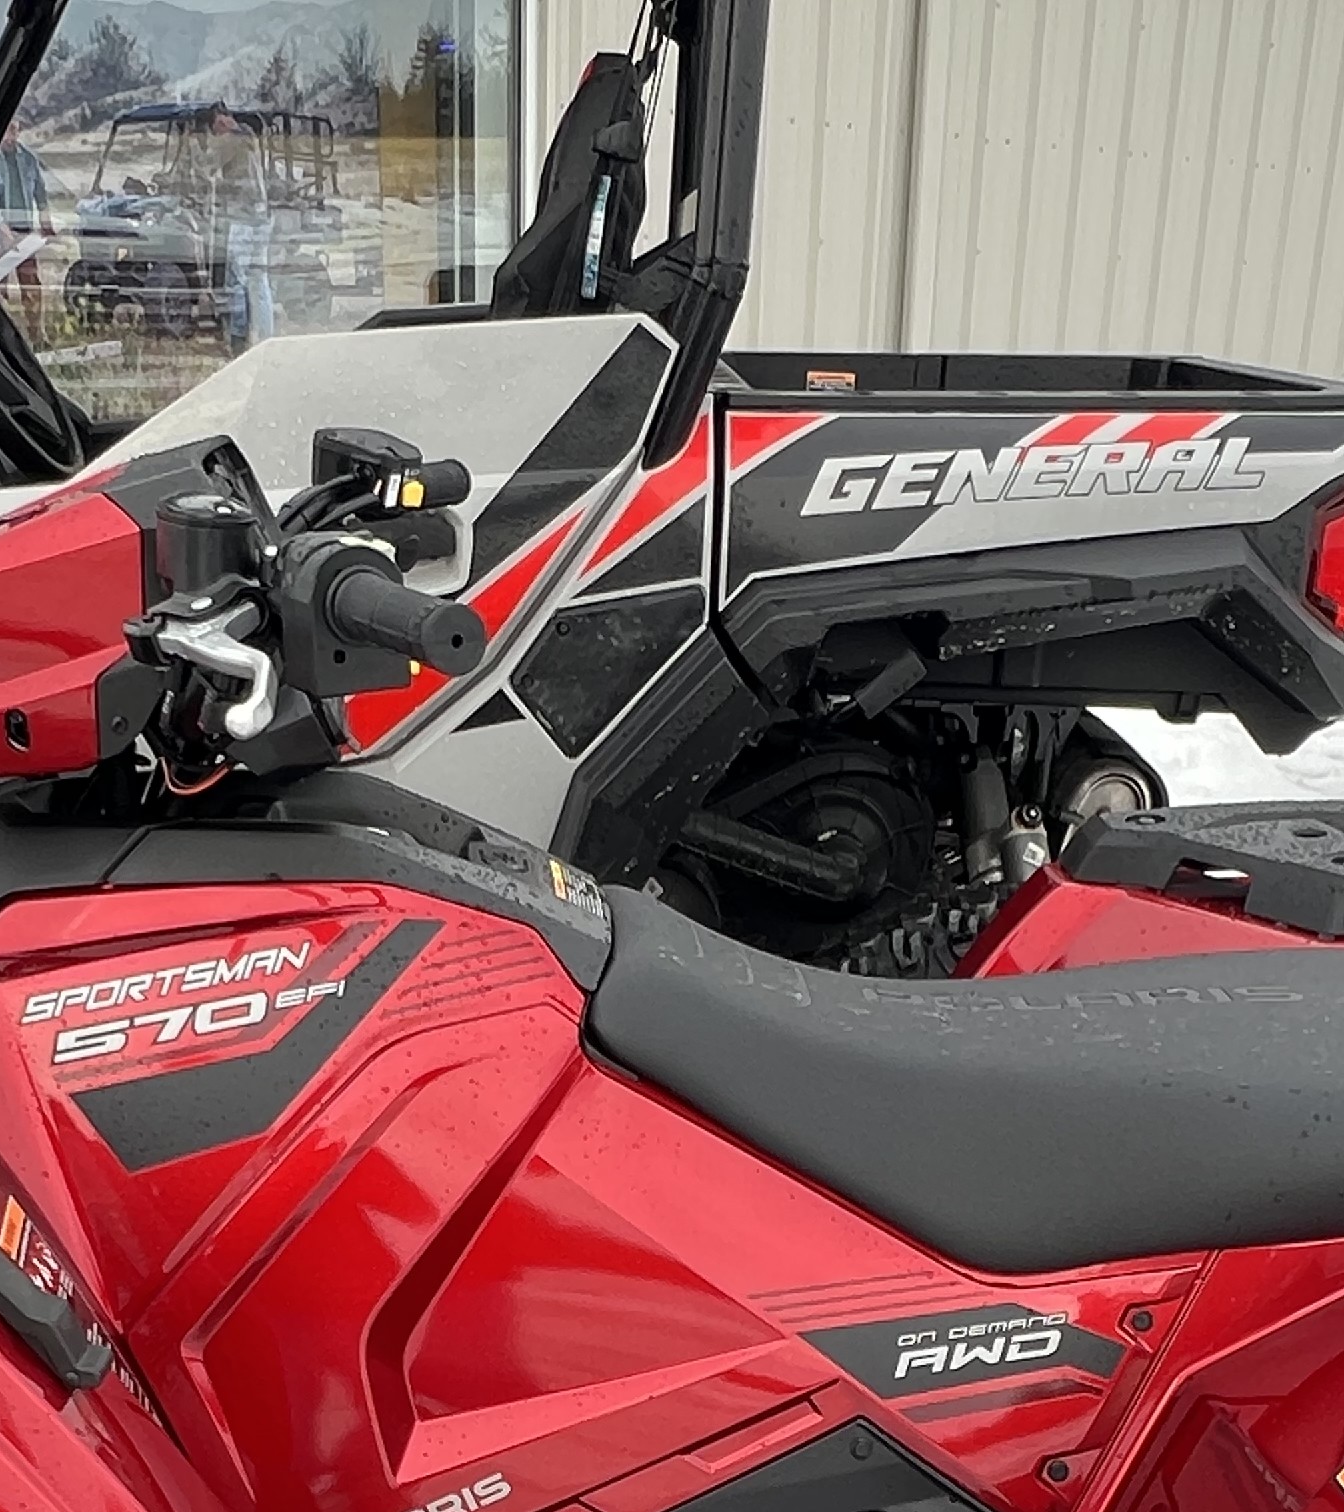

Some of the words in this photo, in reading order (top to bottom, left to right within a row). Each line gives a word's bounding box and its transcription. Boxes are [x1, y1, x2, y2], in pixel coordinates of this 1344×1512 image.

[800, 437, 1265, 517] GENERAL
[20, 942, 311, 1024] SPORTSMAN
[52, 992, 269, 1066] 570
[275, 980, 346, 1010] EFI
[894, 1329, 1062, 1379] AWD
[897, 1330, 938, 1347] ON
[948, 1313, 1068, 1340] DEMAND
